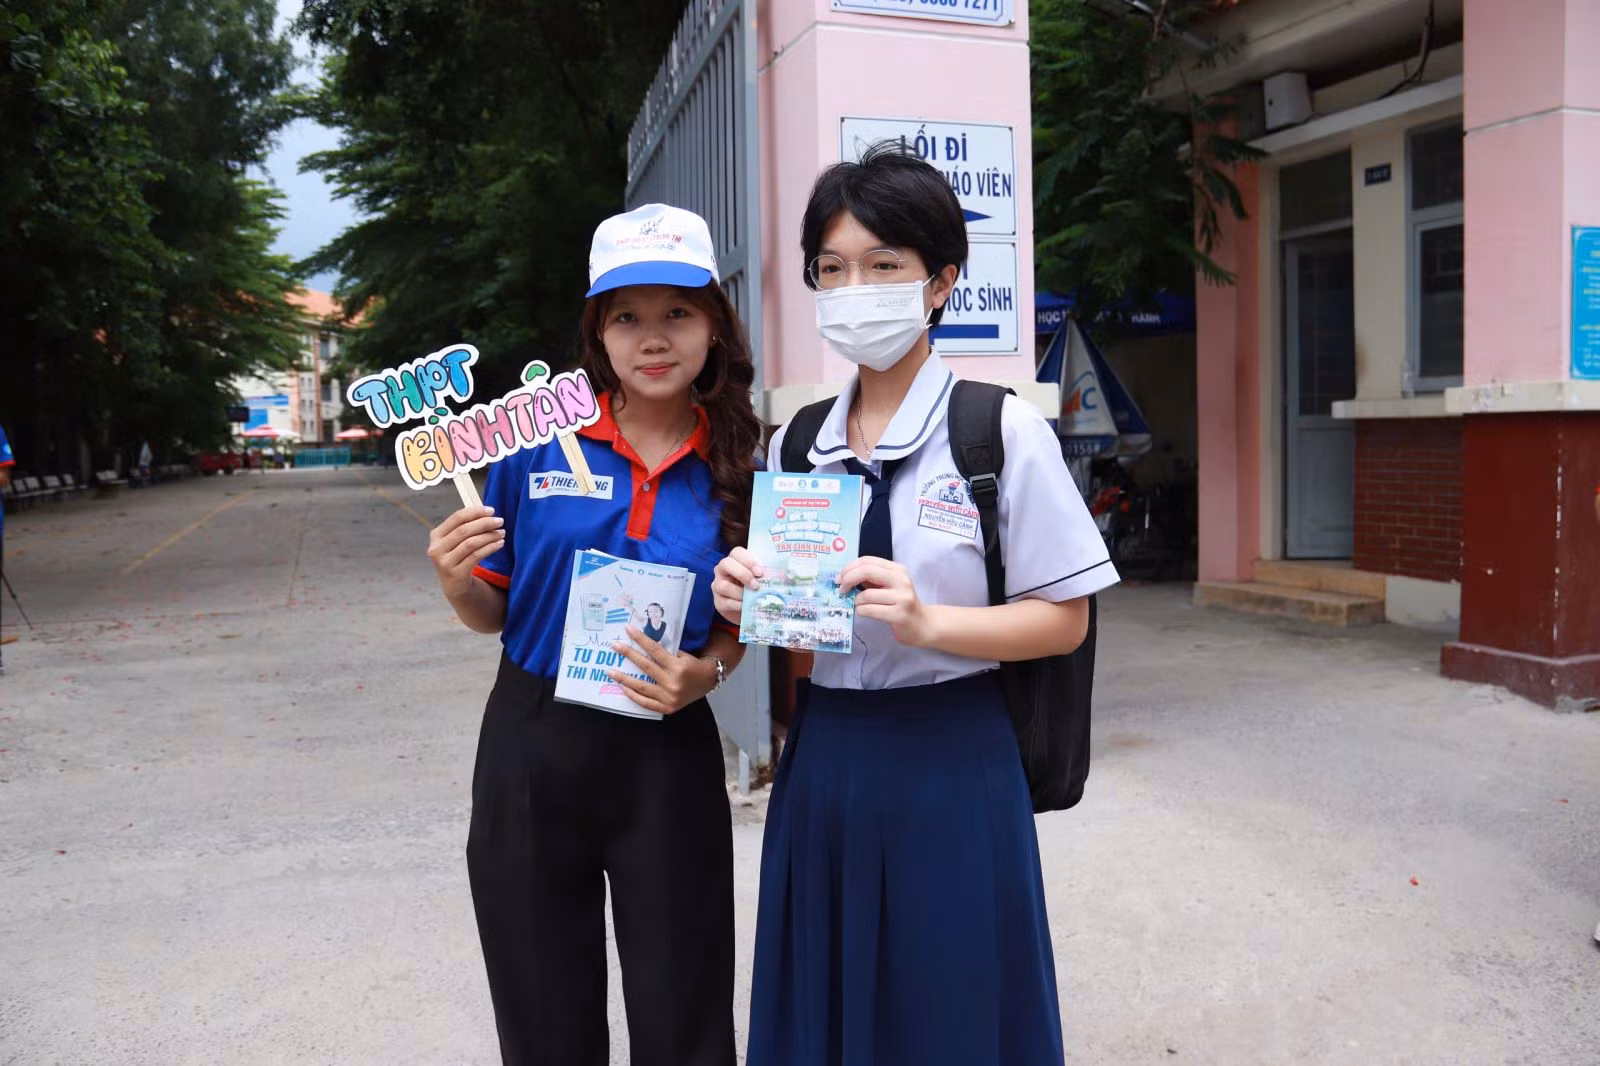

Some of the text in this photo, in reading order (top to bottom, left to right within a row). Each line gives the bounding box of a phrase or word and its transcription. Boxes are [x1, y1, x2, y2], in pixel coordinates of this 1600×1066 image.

[976, 167, 1012, 197] VIÊN
[978, 282, 1013, 312] SINH
[353, 349, 471, 424] THPT
[567, 665, 587, 680] THI
[595, 650, 625, 667] DUY
